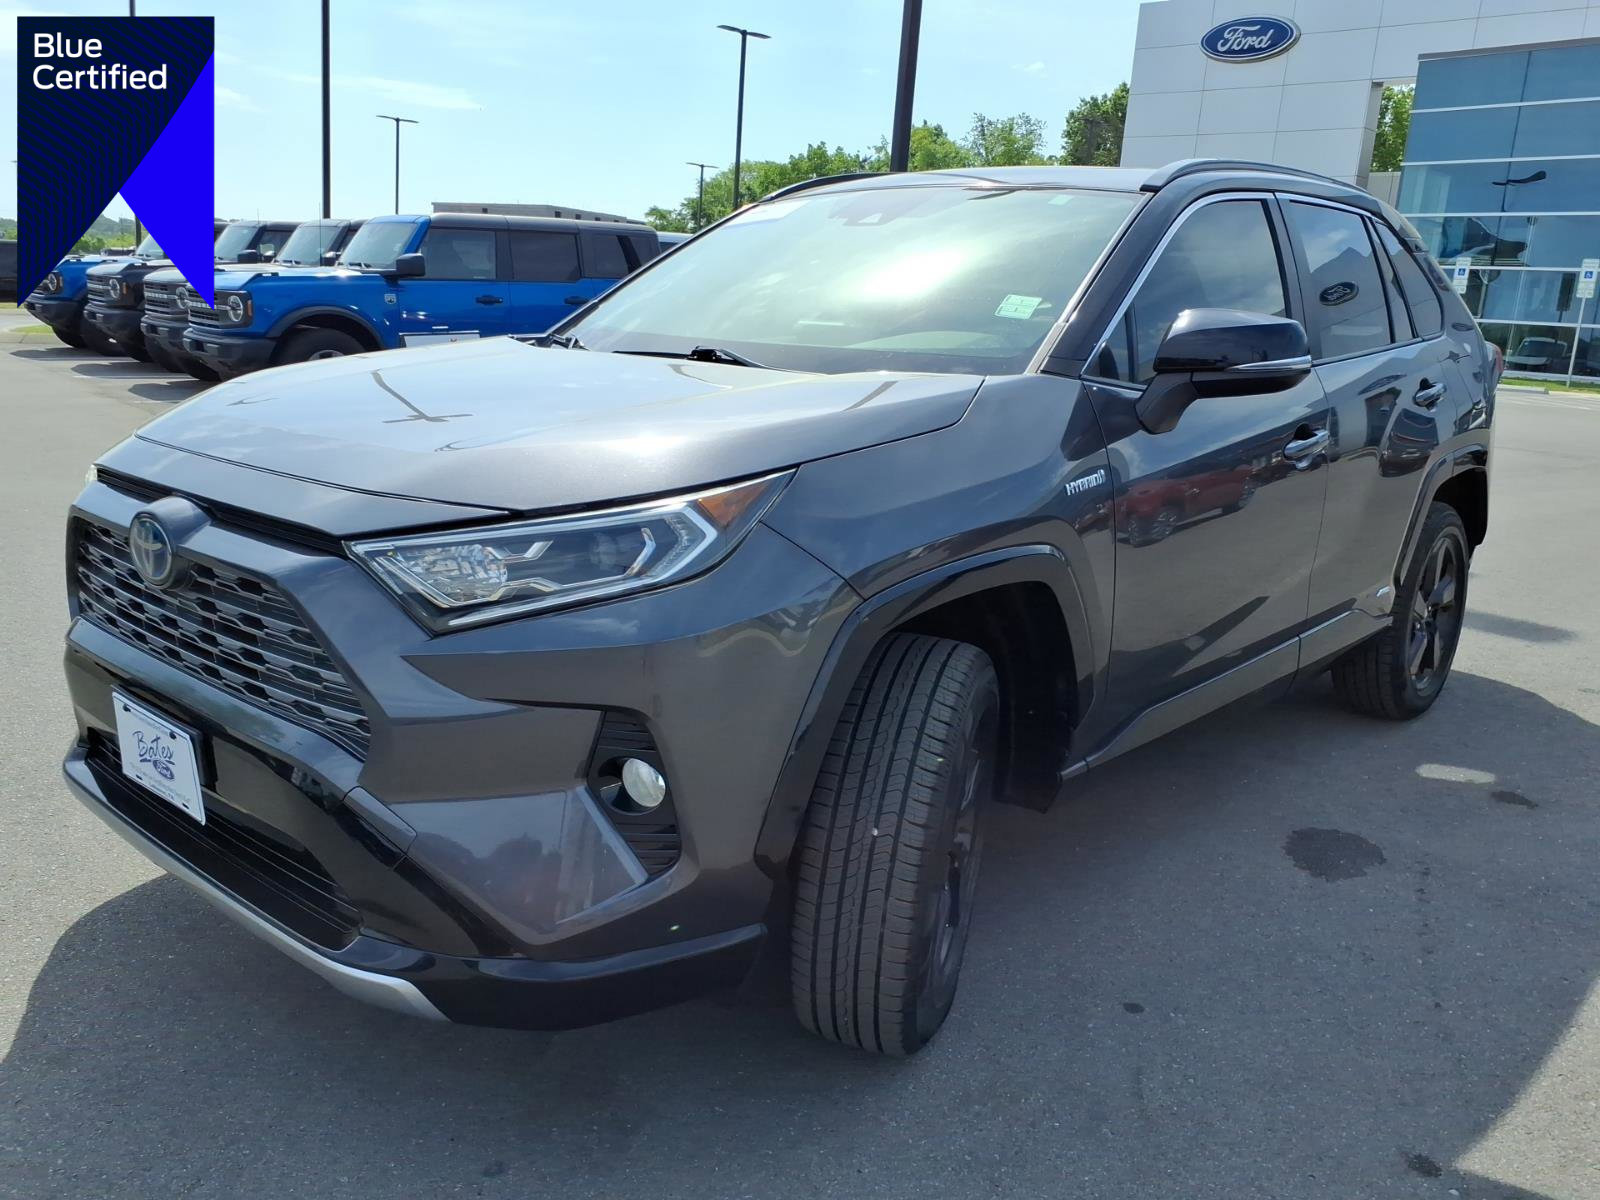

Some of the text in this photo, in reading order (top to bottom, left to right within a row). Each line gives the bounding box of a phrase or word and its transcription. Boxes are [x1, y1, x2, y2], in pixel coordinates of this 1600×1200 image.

[1217, 24, 1275, 52] Ford
[1065, 472, 1100, 496] HYBRID
[132, 730, 175, 759] Bates
